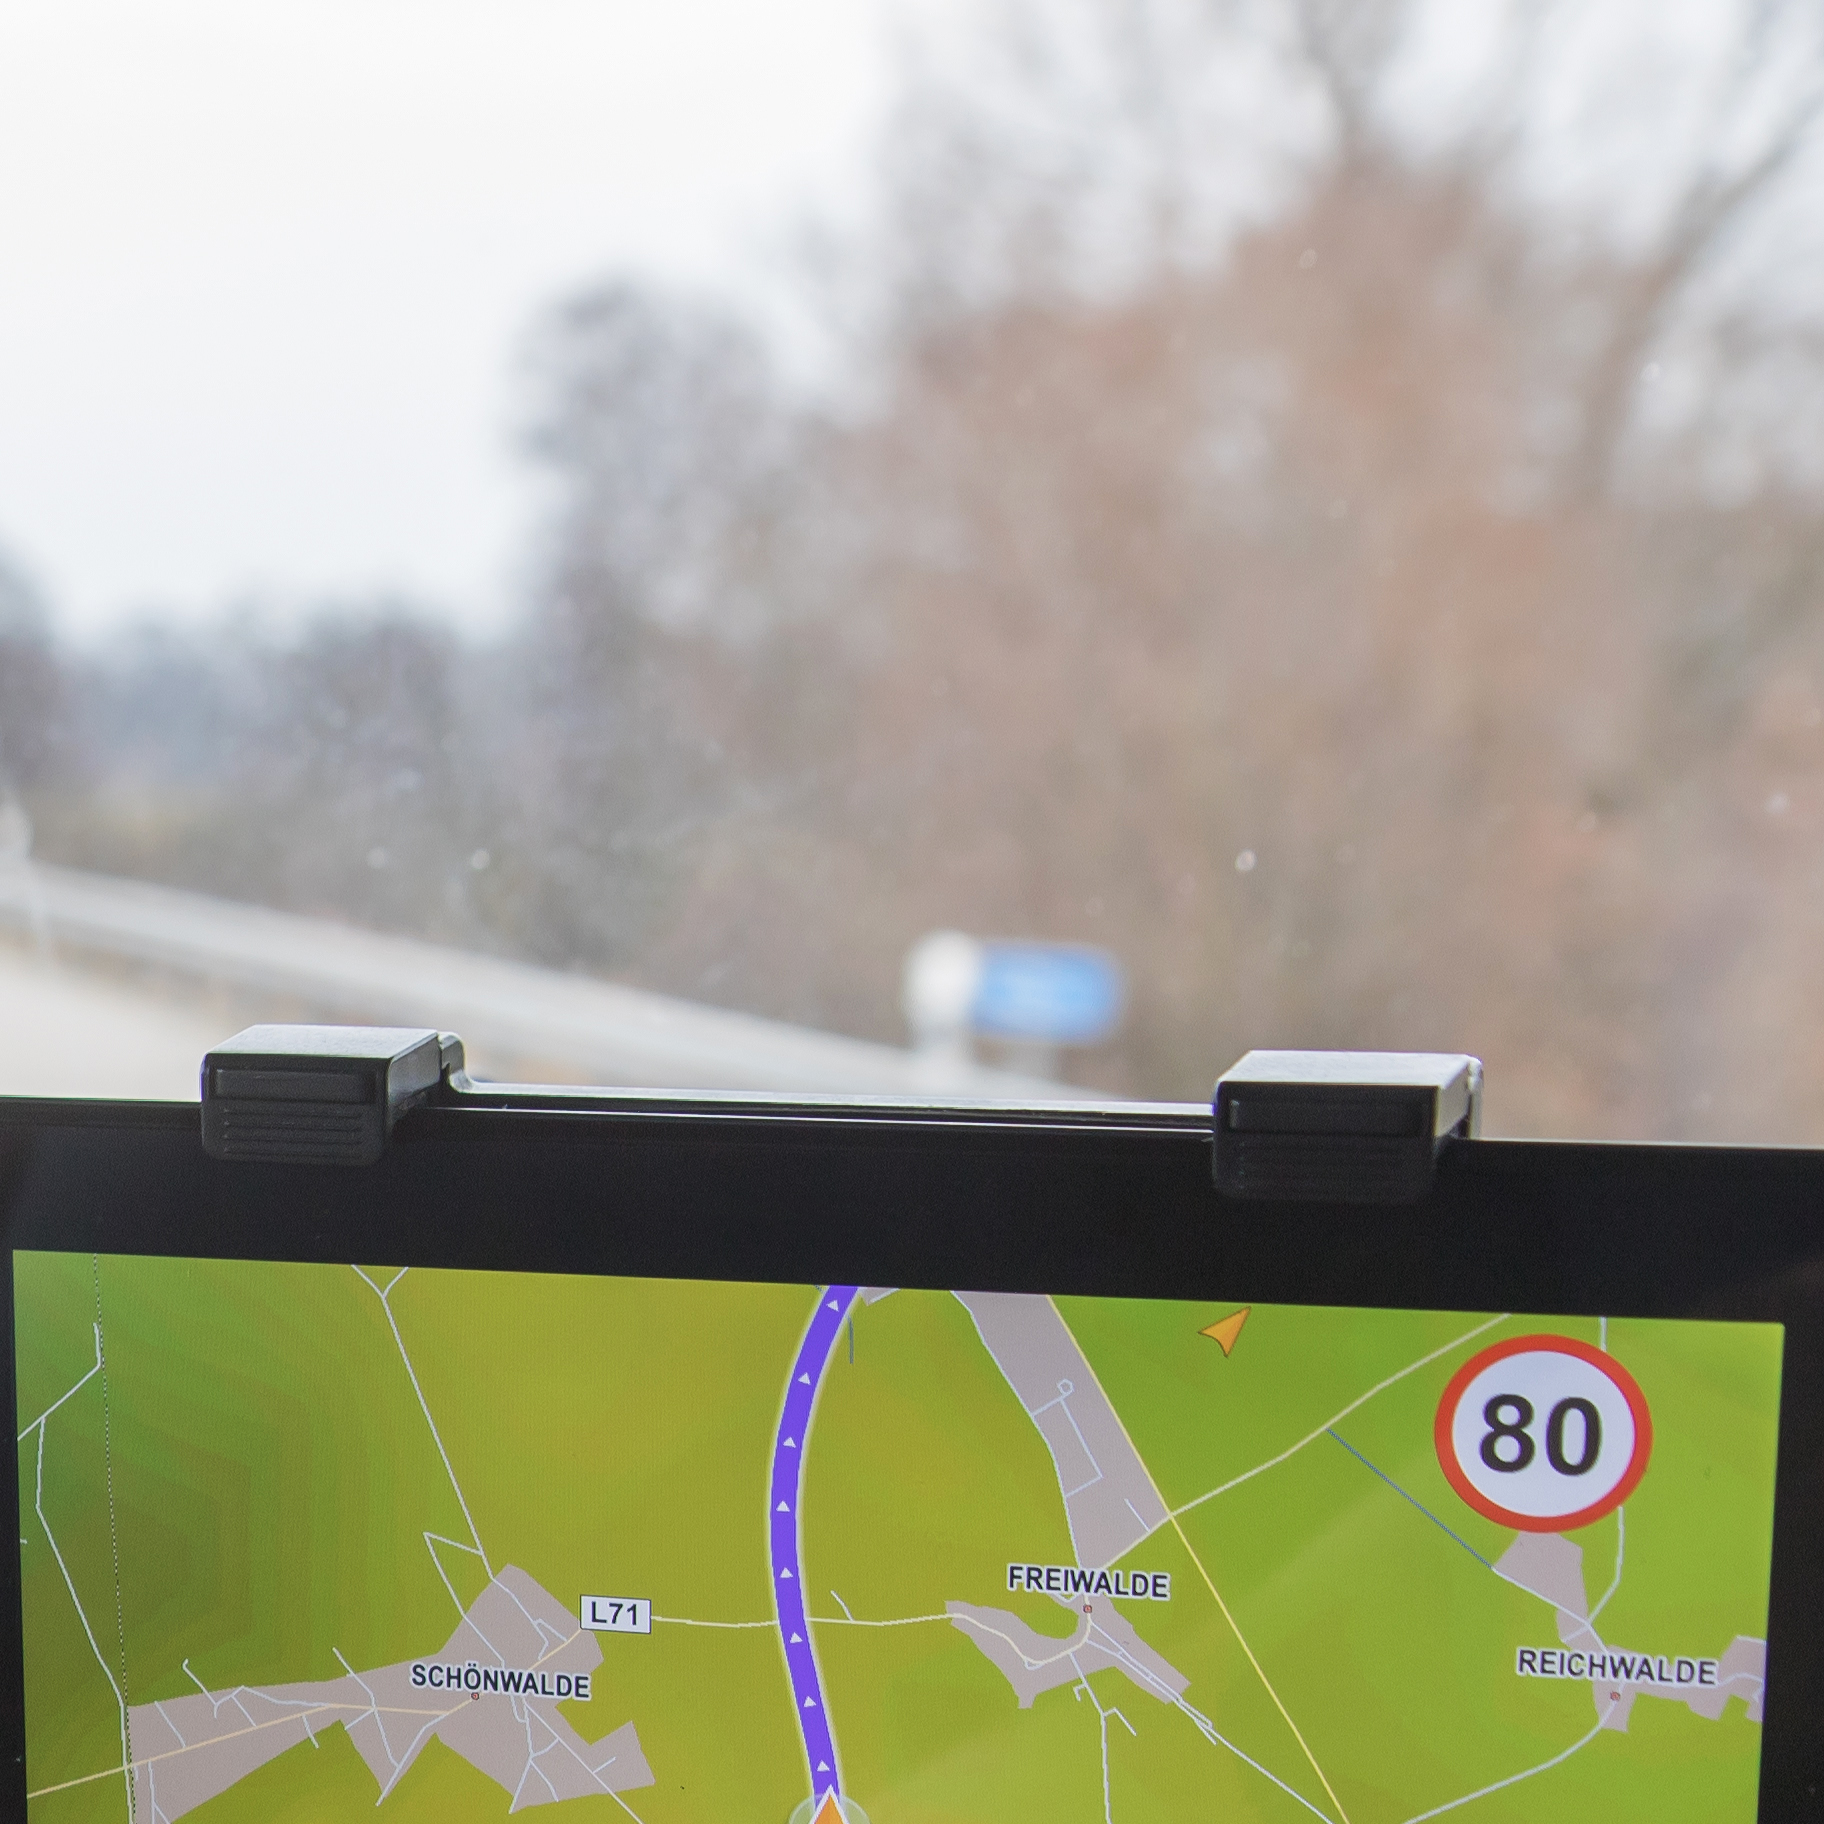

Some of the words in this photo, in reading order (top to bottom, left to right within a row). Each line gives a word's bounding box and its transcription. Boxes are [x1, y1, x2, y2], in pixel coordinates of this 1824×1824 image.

[1480, 1394, 1601, 1475] 80
[1007, 1565, 1169, 1599] FREIWALDE
[590, 1602, 639, 1627] L71
[410, 1663, 590, 1699] SCHÖNWALDE
[1517, 1649, 1716, 1685] REICHWALDE
